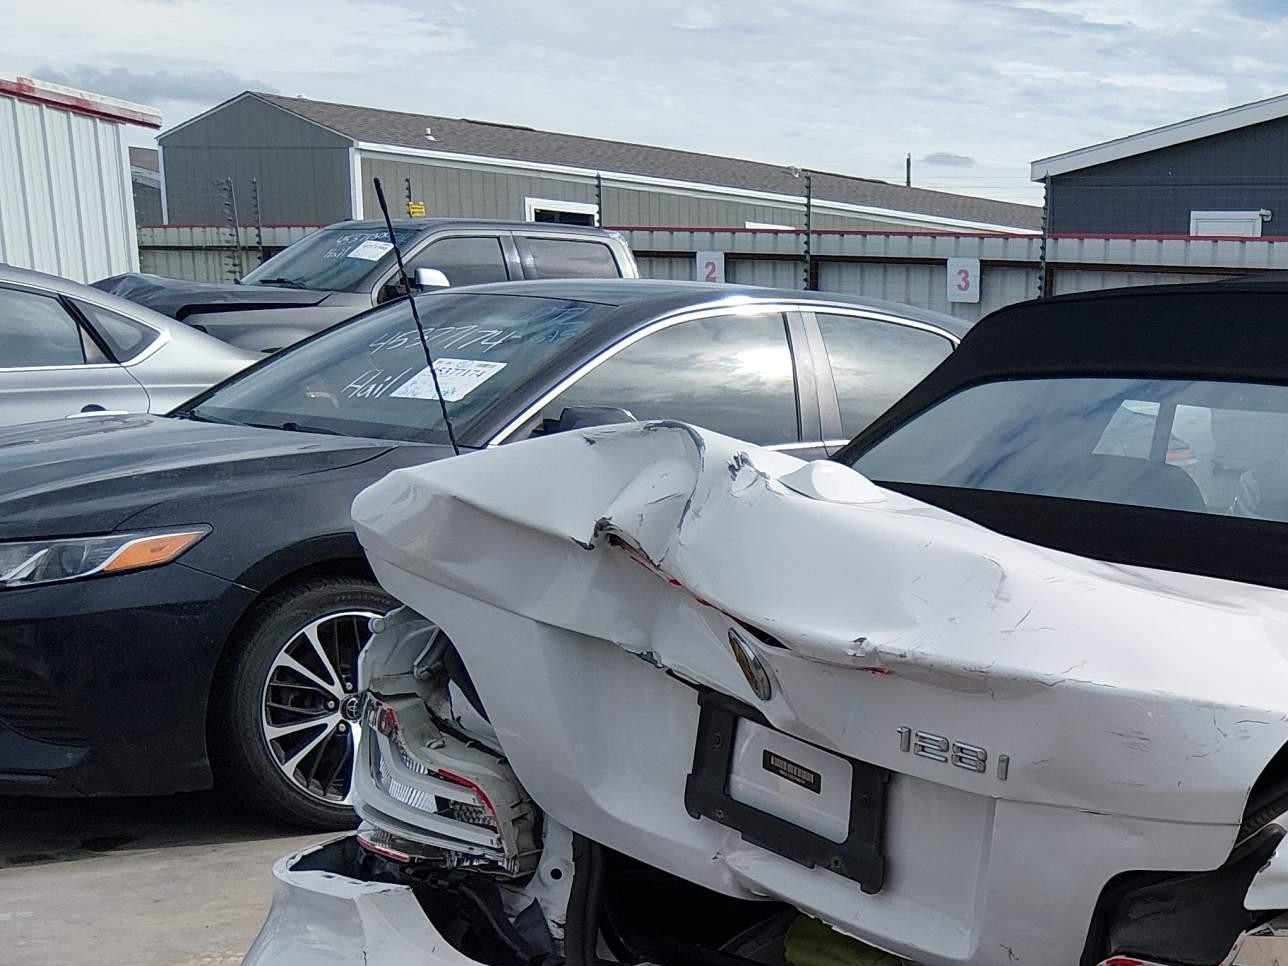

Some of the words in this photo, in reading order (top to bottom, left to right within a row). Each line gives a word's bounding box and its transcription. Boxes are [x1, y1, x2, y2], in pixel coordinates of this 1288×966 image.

[704, 261, 717, 282] 2
[956, 268, 971, 291] 3
[342, 367, 413, 399] Hail
